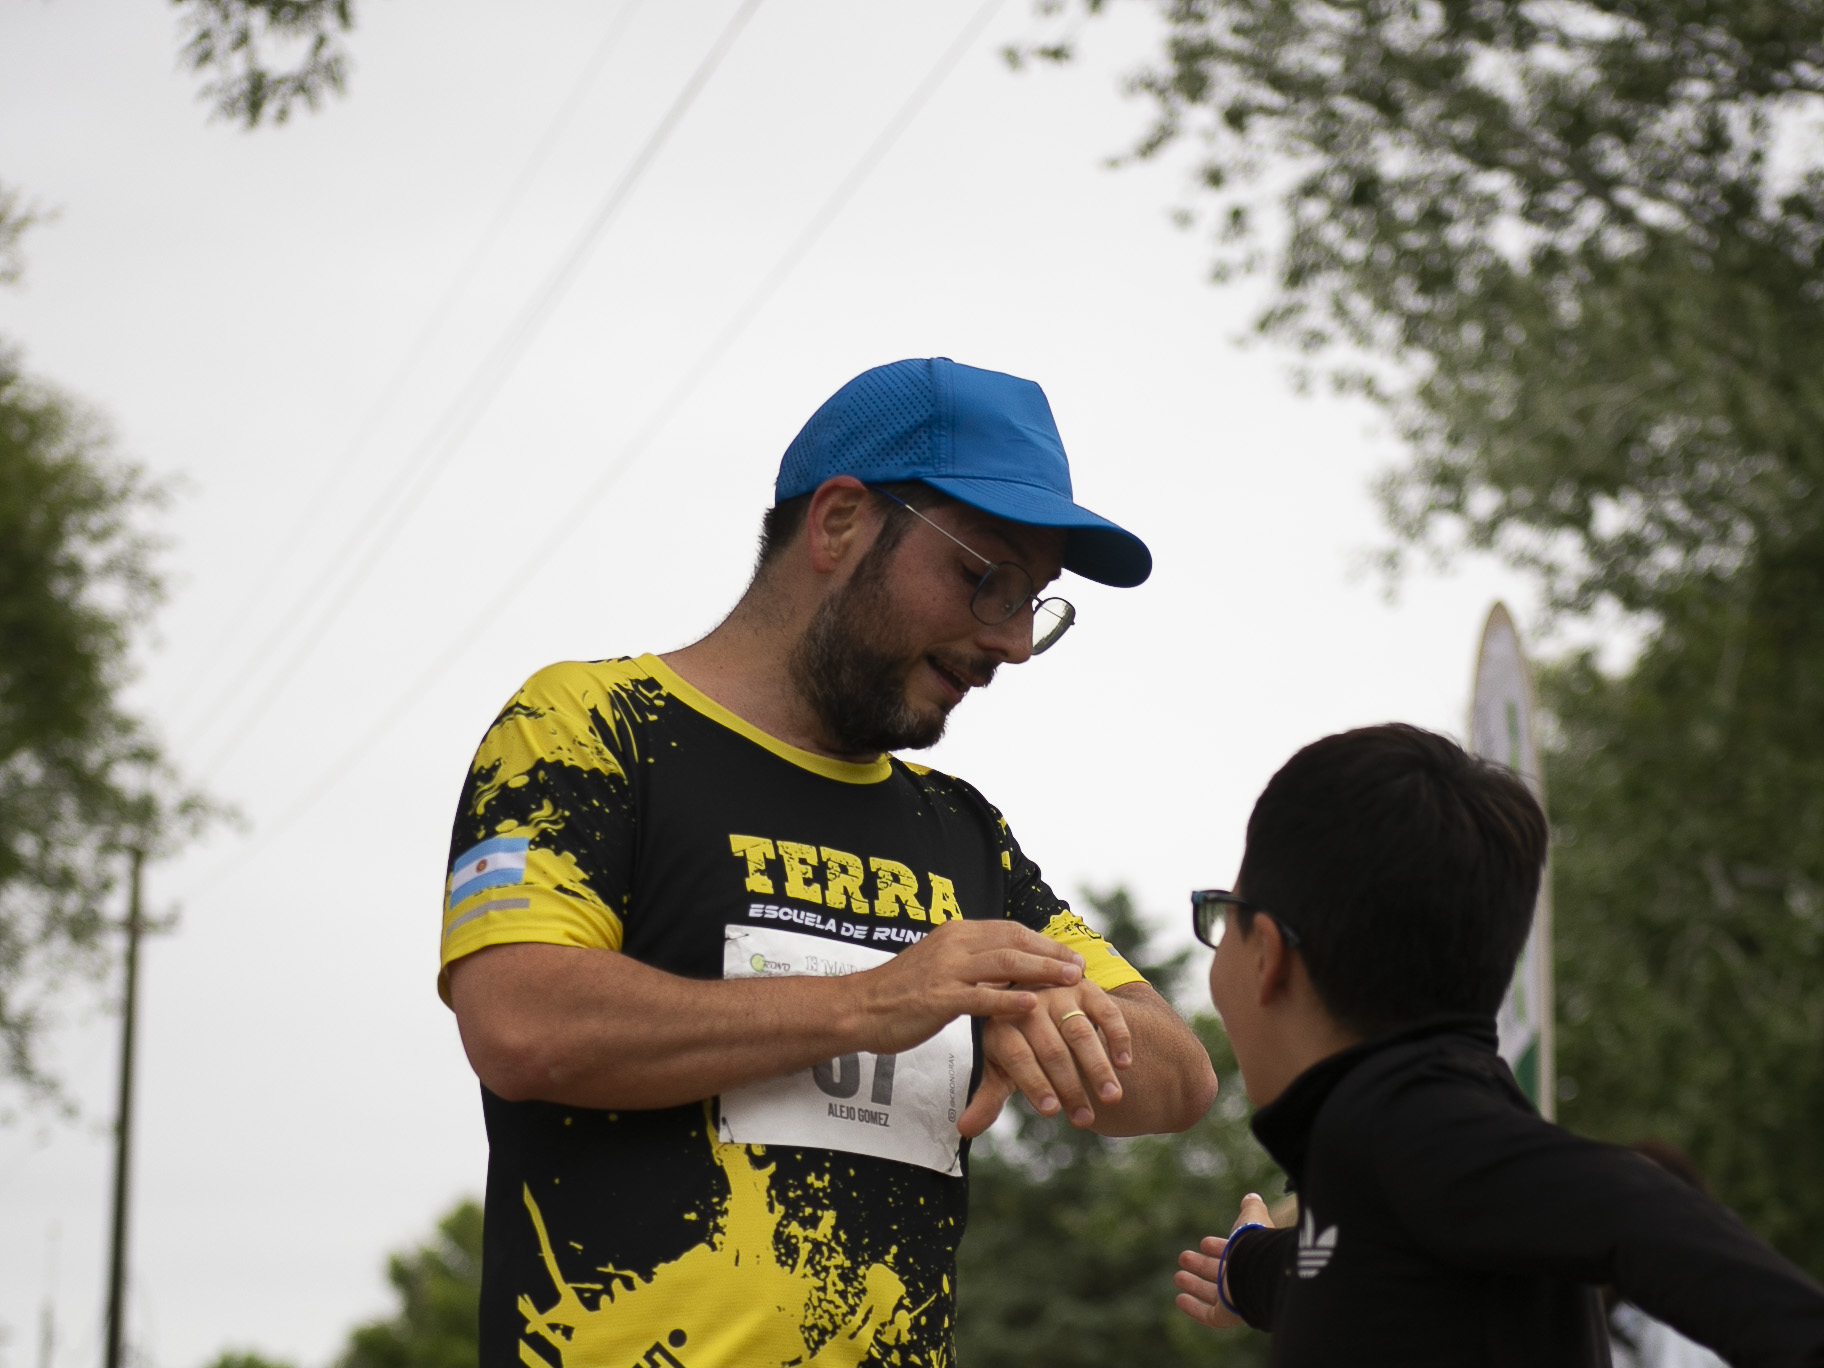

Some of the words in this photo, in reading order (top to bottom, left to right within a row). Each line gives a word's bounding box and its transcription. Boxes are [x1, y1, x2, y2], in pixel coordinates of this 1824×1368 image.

[729, 834, 963, 925] TERRA
[749, 904, 836, 932] ESCUELA
[841, 922, 869, 939] DE
[828, 1103, 855, 1120] ALEJO
[858, 1108, 890, 1127] GOMEZ
